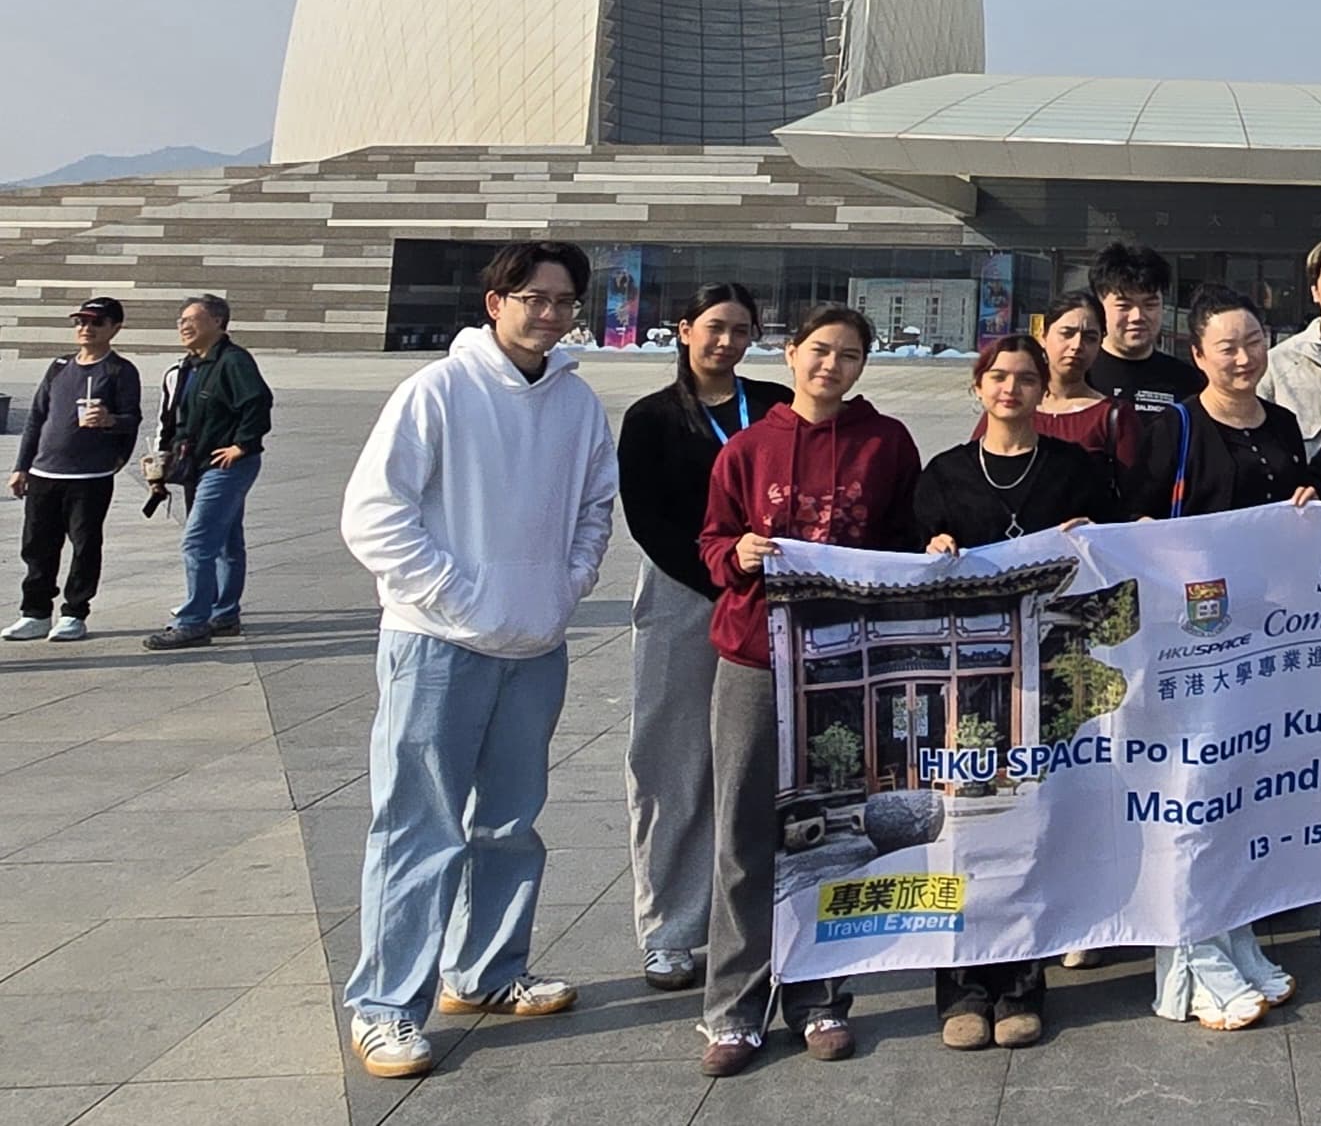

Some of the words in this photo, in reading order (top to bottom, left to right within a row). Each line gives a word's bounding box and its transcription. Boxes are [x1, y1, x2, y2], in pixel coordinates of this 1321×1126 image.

[1157, 632, 1253, 661] HKUSPACE
[921, 749, 996, 781] HKU
[1008, 736, 1112, 778] SPACE
[1126, 739, 1168, 763] Po
[1181, 723, 1272, 765] Leung
[1126, 787, 1243, 825] Macau
[1253, 758, 1320, 802] and
[1249, 836, 1270, 860] 13
[824, 875, 960, 916] 專業旅運
[822, 914, 879, 937] Travel
[883, 912, 958, 933] Expert
